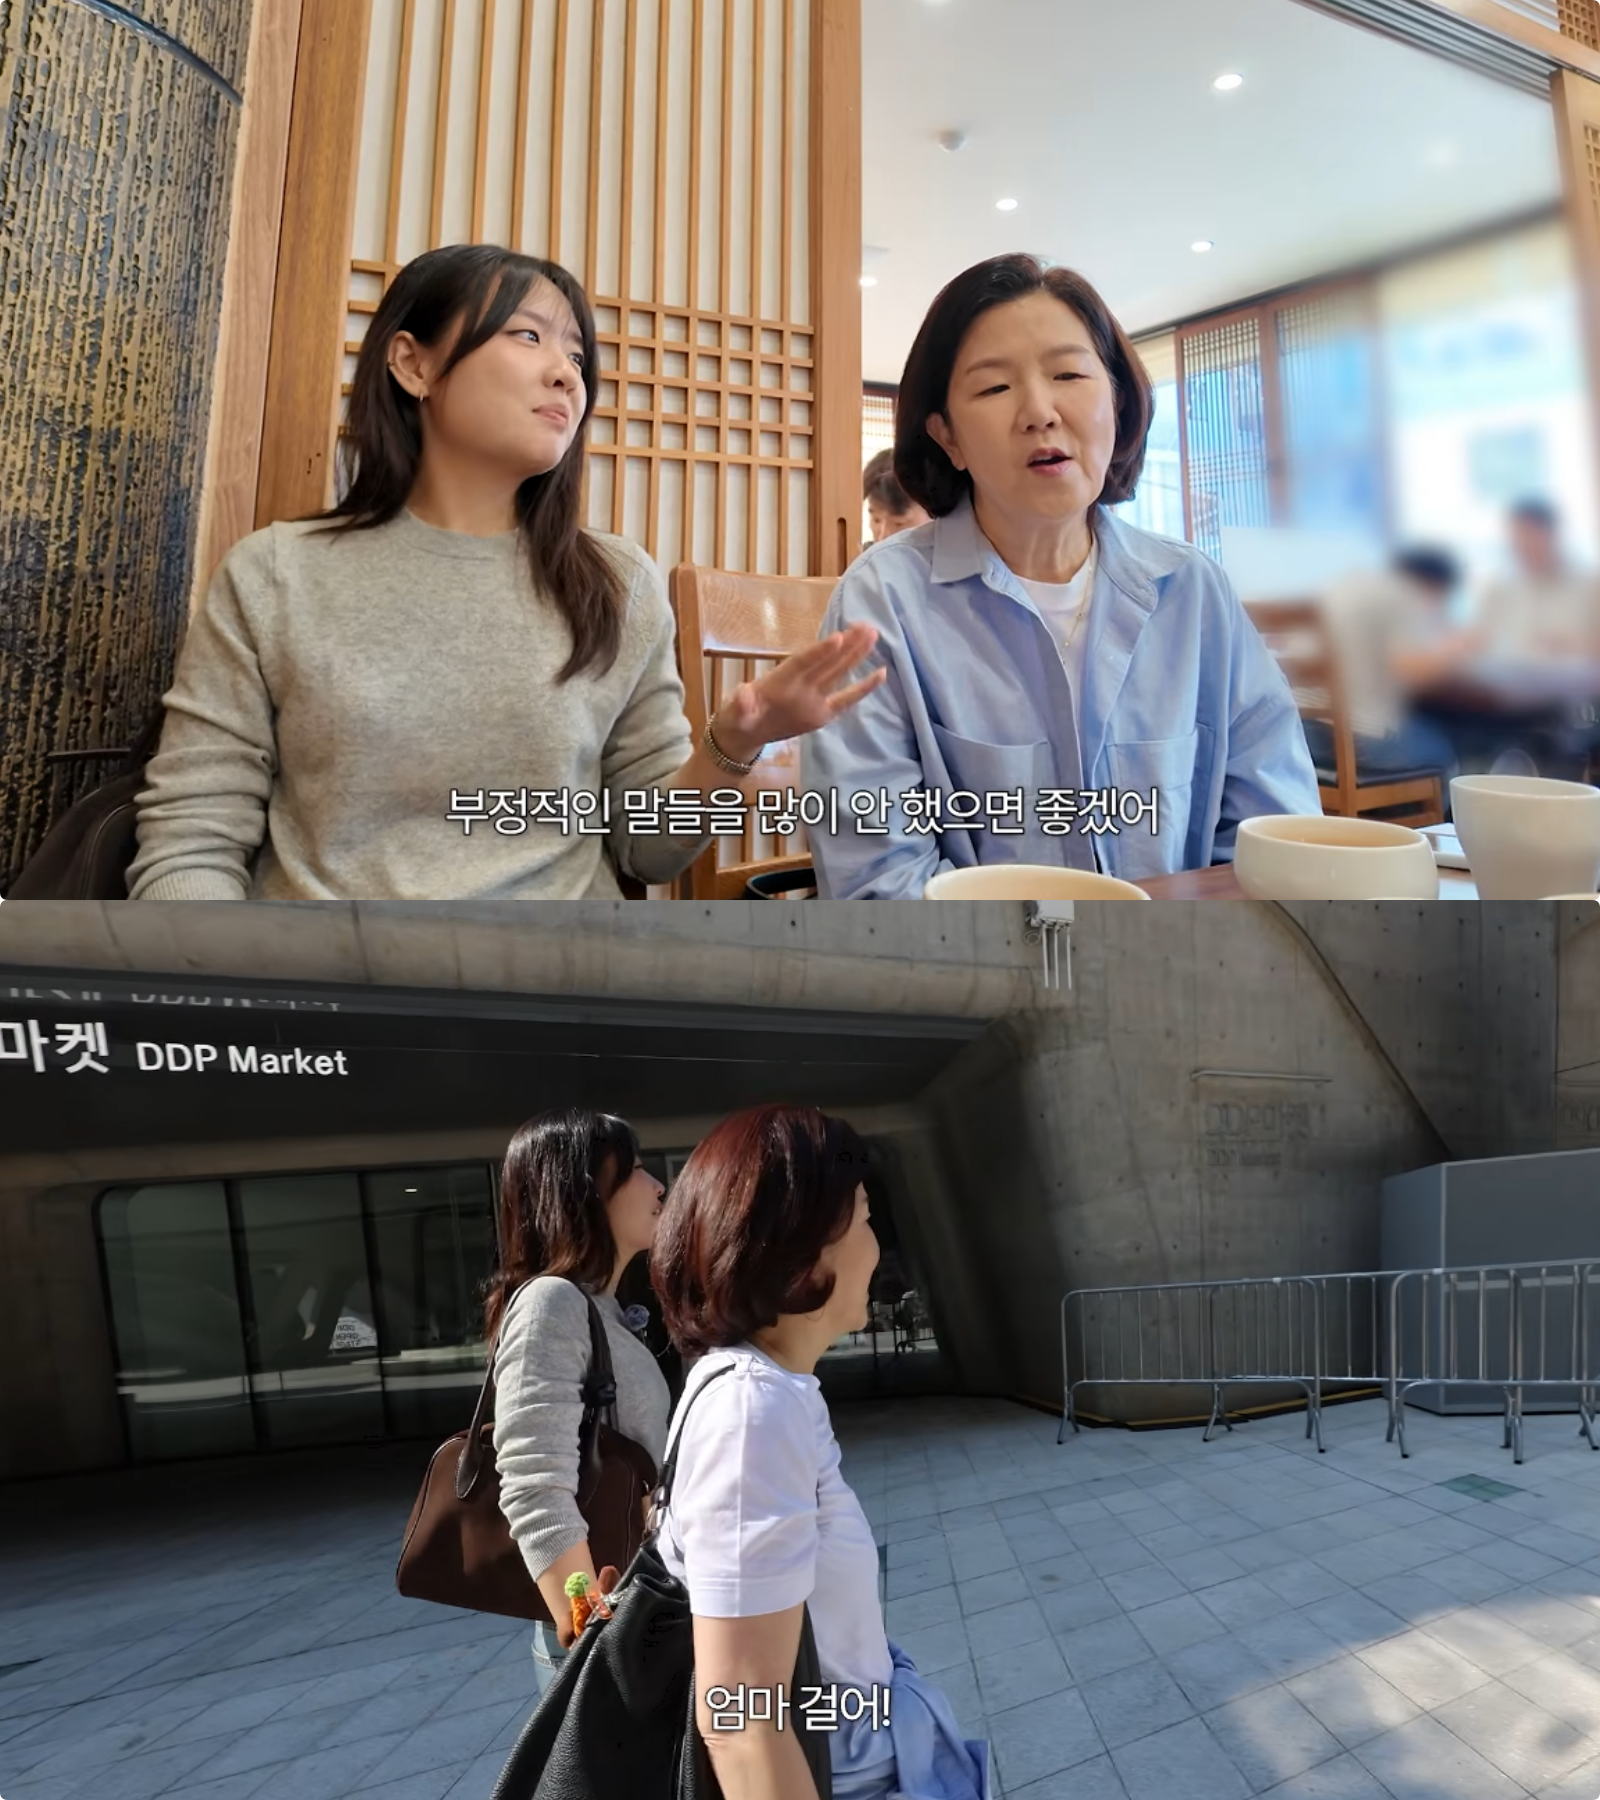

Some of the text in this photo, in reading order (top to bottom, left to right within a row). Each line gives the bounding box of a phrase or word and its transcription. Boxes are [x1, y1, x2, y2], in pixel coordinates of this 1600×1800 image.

[0, 1019, 109, 1074] 마켓
[136, 1042, 348, 1075] DDP Market
